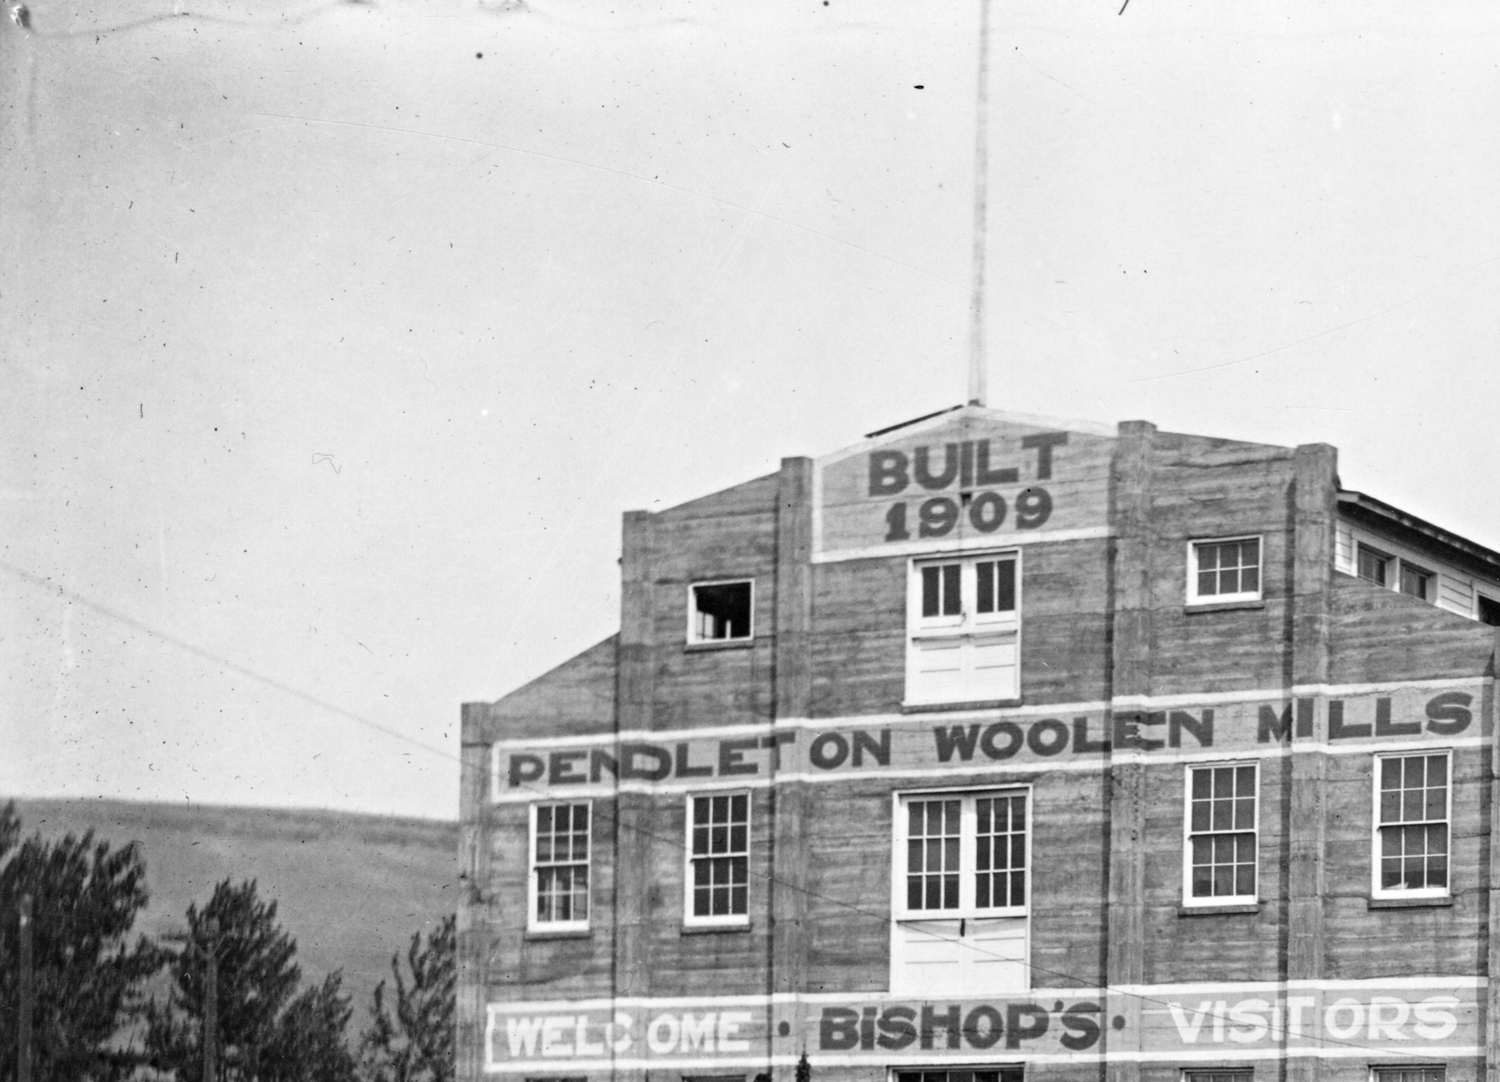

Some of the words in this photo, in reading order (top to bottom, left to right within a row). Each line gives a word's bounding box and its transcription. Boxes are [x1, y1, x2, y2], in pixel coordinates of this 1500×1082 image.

[868, 431, 1069, 497] BUILT
[884, 486, 1053, 542] 1909
[508, 729, 891, 788] PENDLETON
[933, 709, 1215, 763] WOOLEN
[1256, 690, 1474, 744] MILLS
[507, 1012, 752, 1057] WELCOME
[819, 1000, 1102, 1051] BISHOP'S
[1167, 996, 1461, 1043] VISITORS
